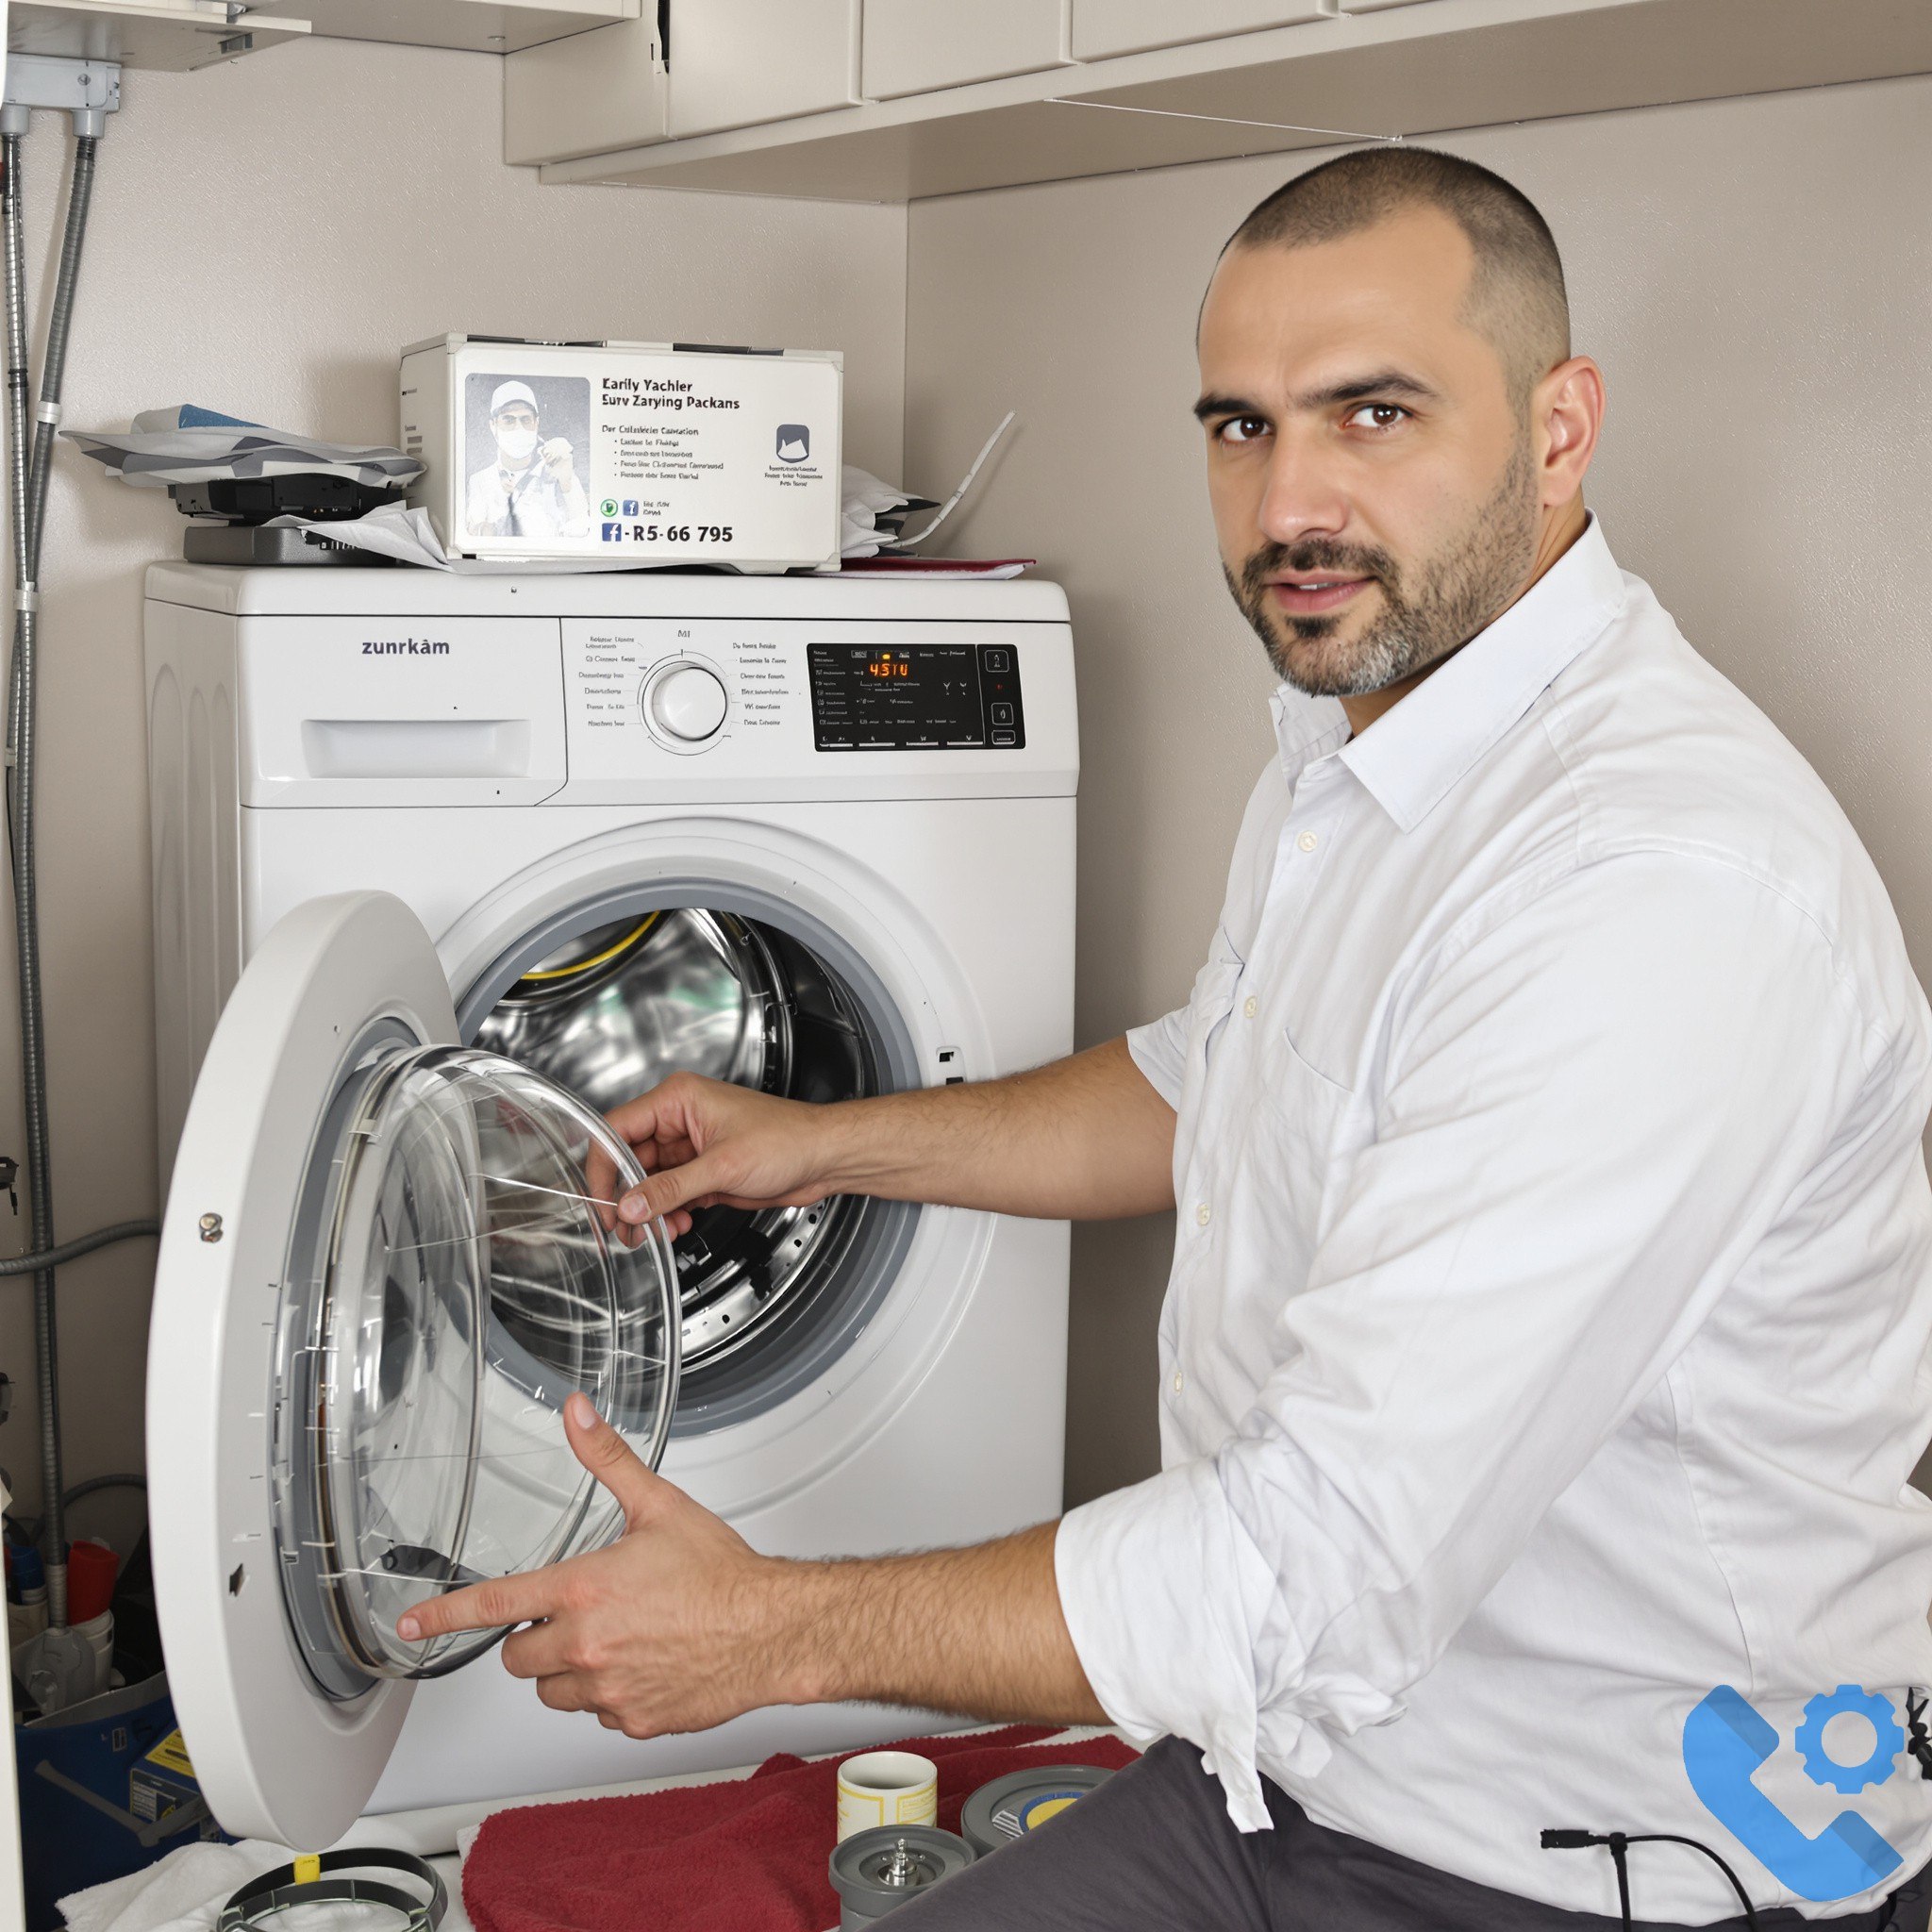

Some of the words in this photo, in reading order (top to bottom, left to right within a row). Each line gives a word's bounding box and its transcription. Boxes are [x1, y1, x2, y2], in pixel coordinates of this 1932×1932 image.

[643, 379, 693, 392] Yachler
[687, 396, 741, 409] Packans
[697, 526, 733, 542] 795
